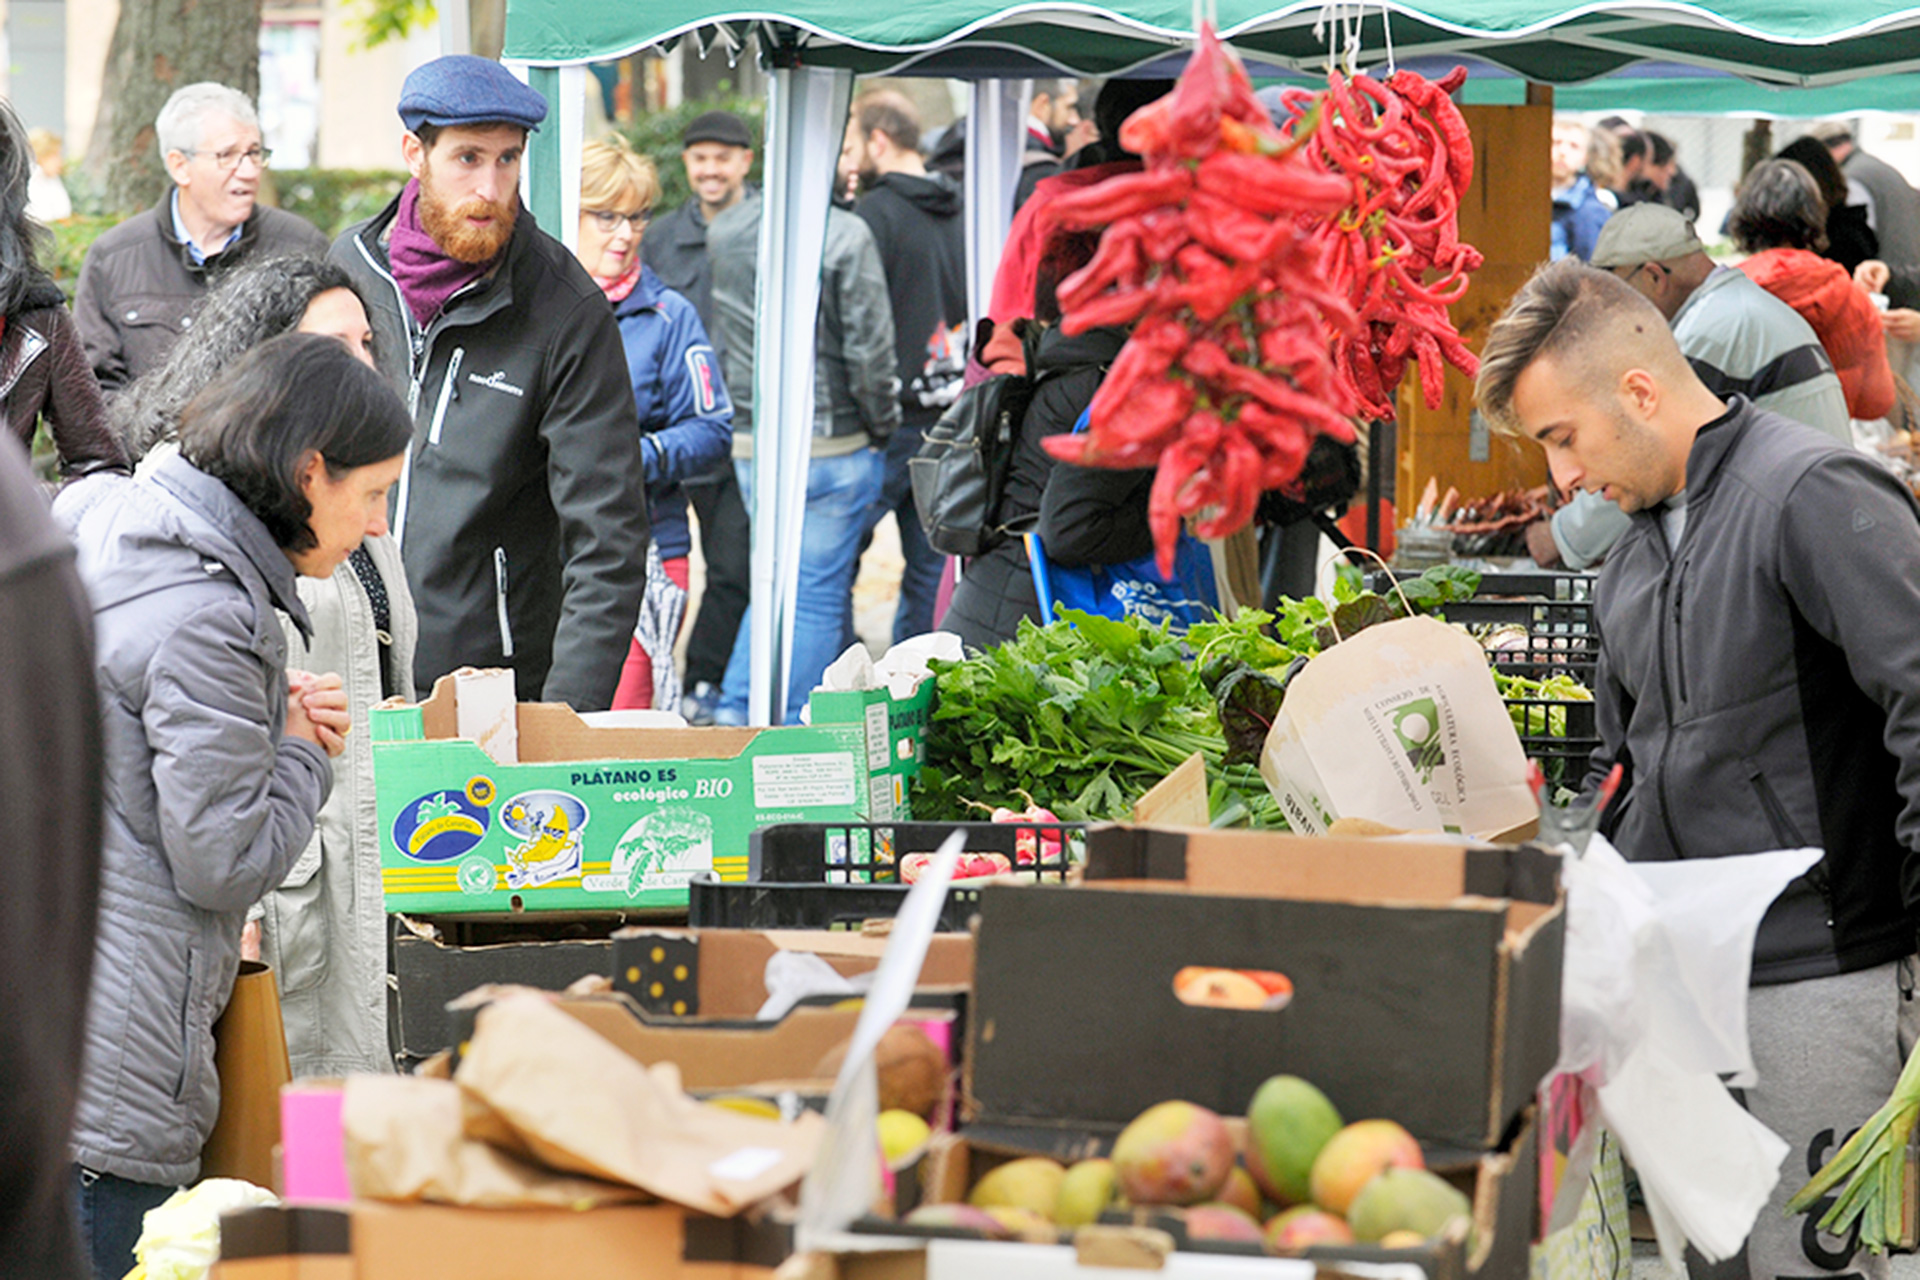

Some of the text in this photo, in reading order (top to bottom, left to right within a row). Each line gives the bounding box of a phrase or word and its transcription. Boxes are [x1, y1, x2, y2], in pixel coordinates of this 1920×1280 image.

[571, 768, 677, 786] PLÁTANO ES
[1451, 749, 1467, 804] ECOLÓGICA
[613, 778, 734, 803] ecológico BIO
[588, 876, 625, 889] Verde
